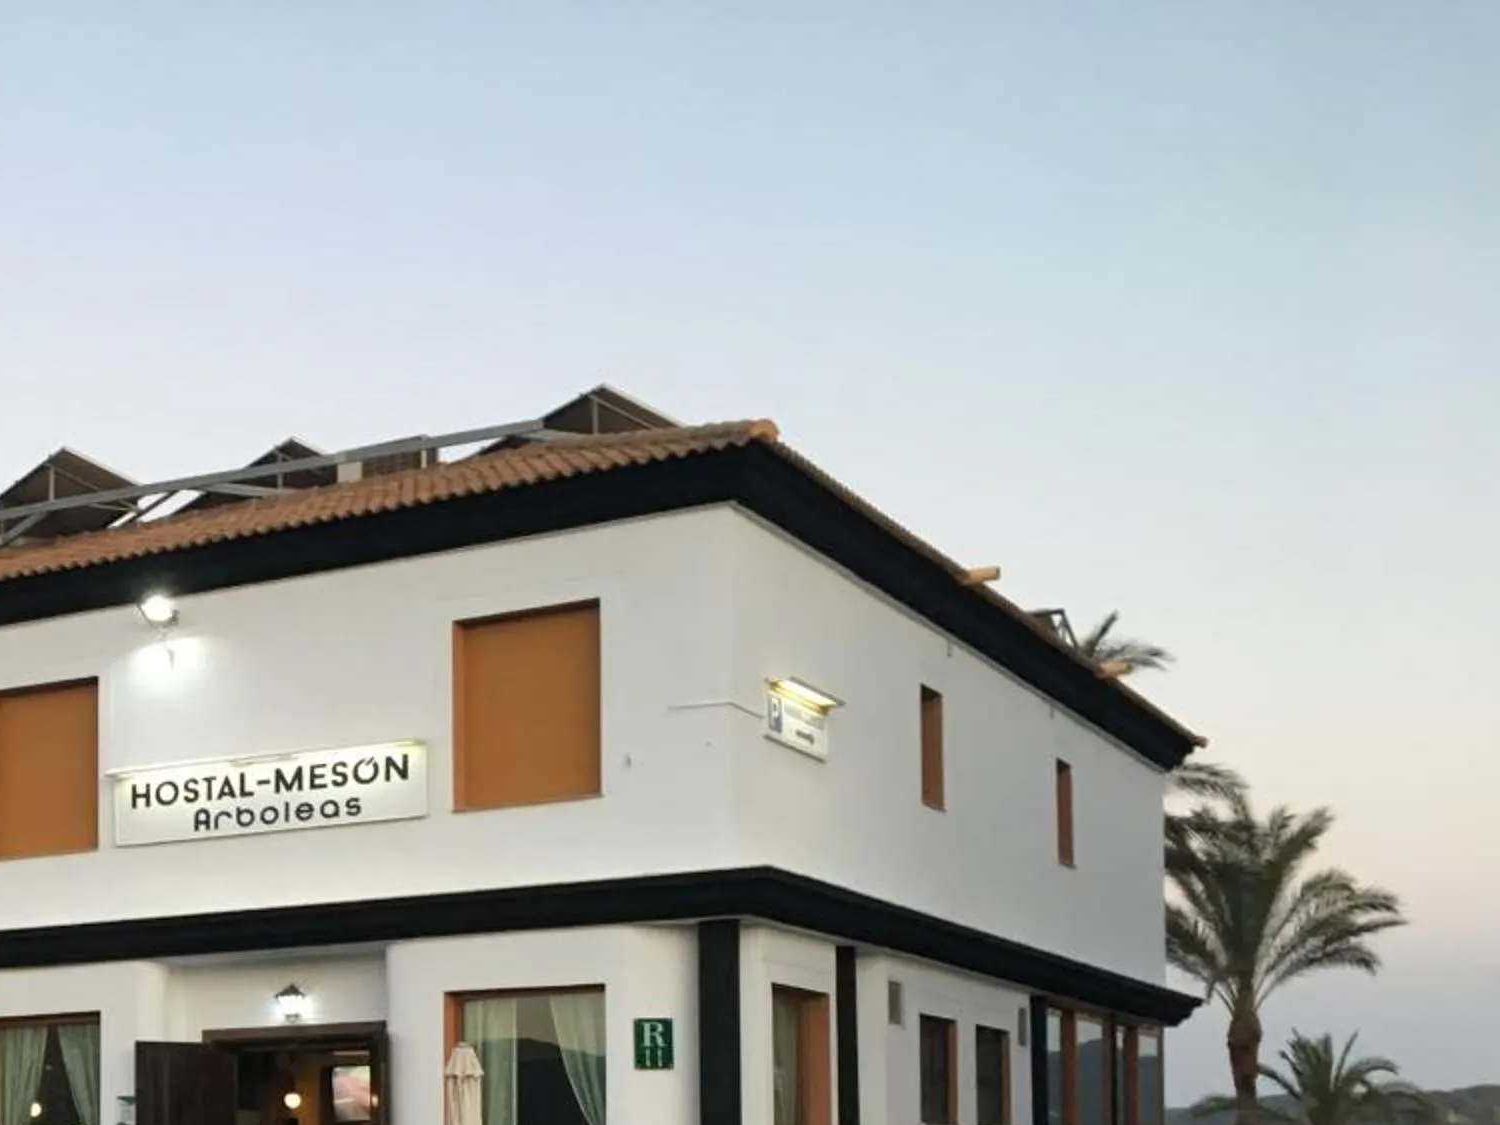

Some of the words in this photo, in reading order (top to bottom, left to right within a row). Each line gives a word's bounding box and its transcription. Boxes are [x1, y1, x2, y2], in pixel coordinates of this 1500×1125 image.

[131, 754, 410, 809] HOSTAL-MESÓN
[194, 797, 362, 831] Arboleas
[642, 1021, 667, 1046] R
